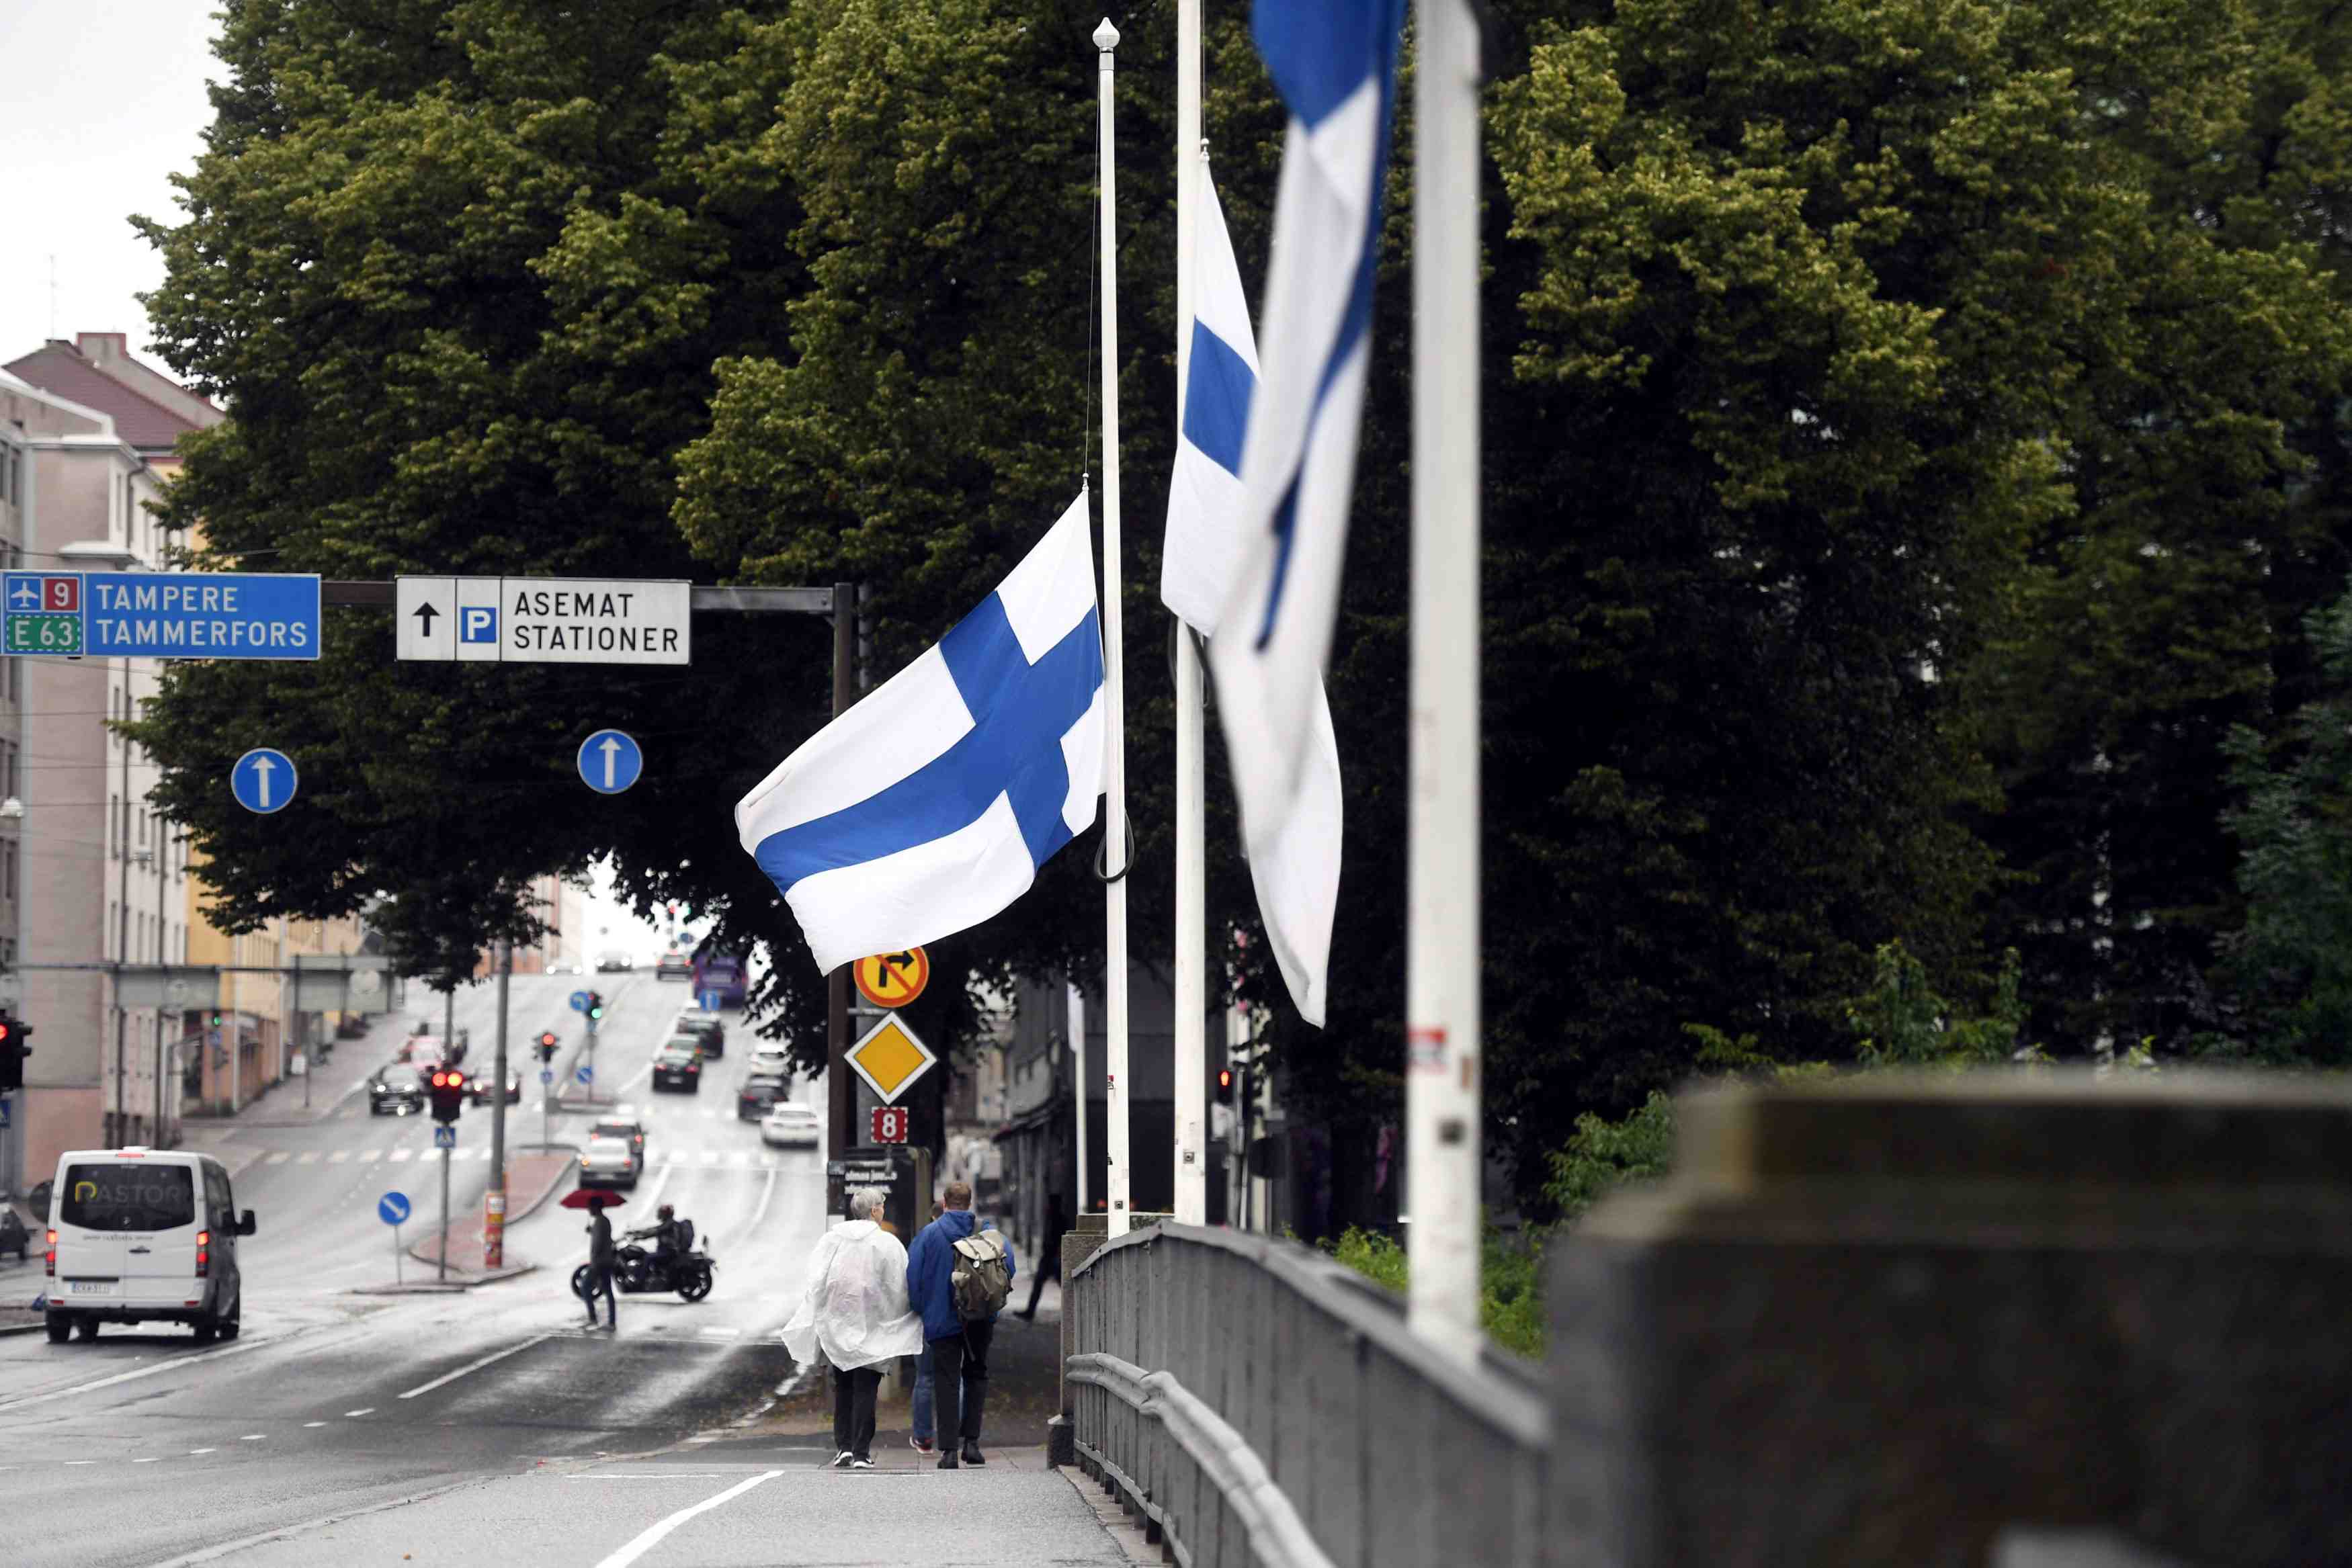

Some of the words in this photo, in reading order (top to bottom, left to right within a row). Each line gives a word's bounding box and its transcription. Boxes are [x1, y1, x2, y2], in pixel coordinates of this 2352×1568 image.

[54, 582, 70, 607] 9
[95, 584, 239, 613] TAMPERE
[514, 591, 634, 618] ASEMAT
[95, 619, 307, 647] TAMMERFORS
[467, 609, 491, 640] P
[514, 625, 679, 652] STATIONER
[882, 1113, 897, 1139] 8
